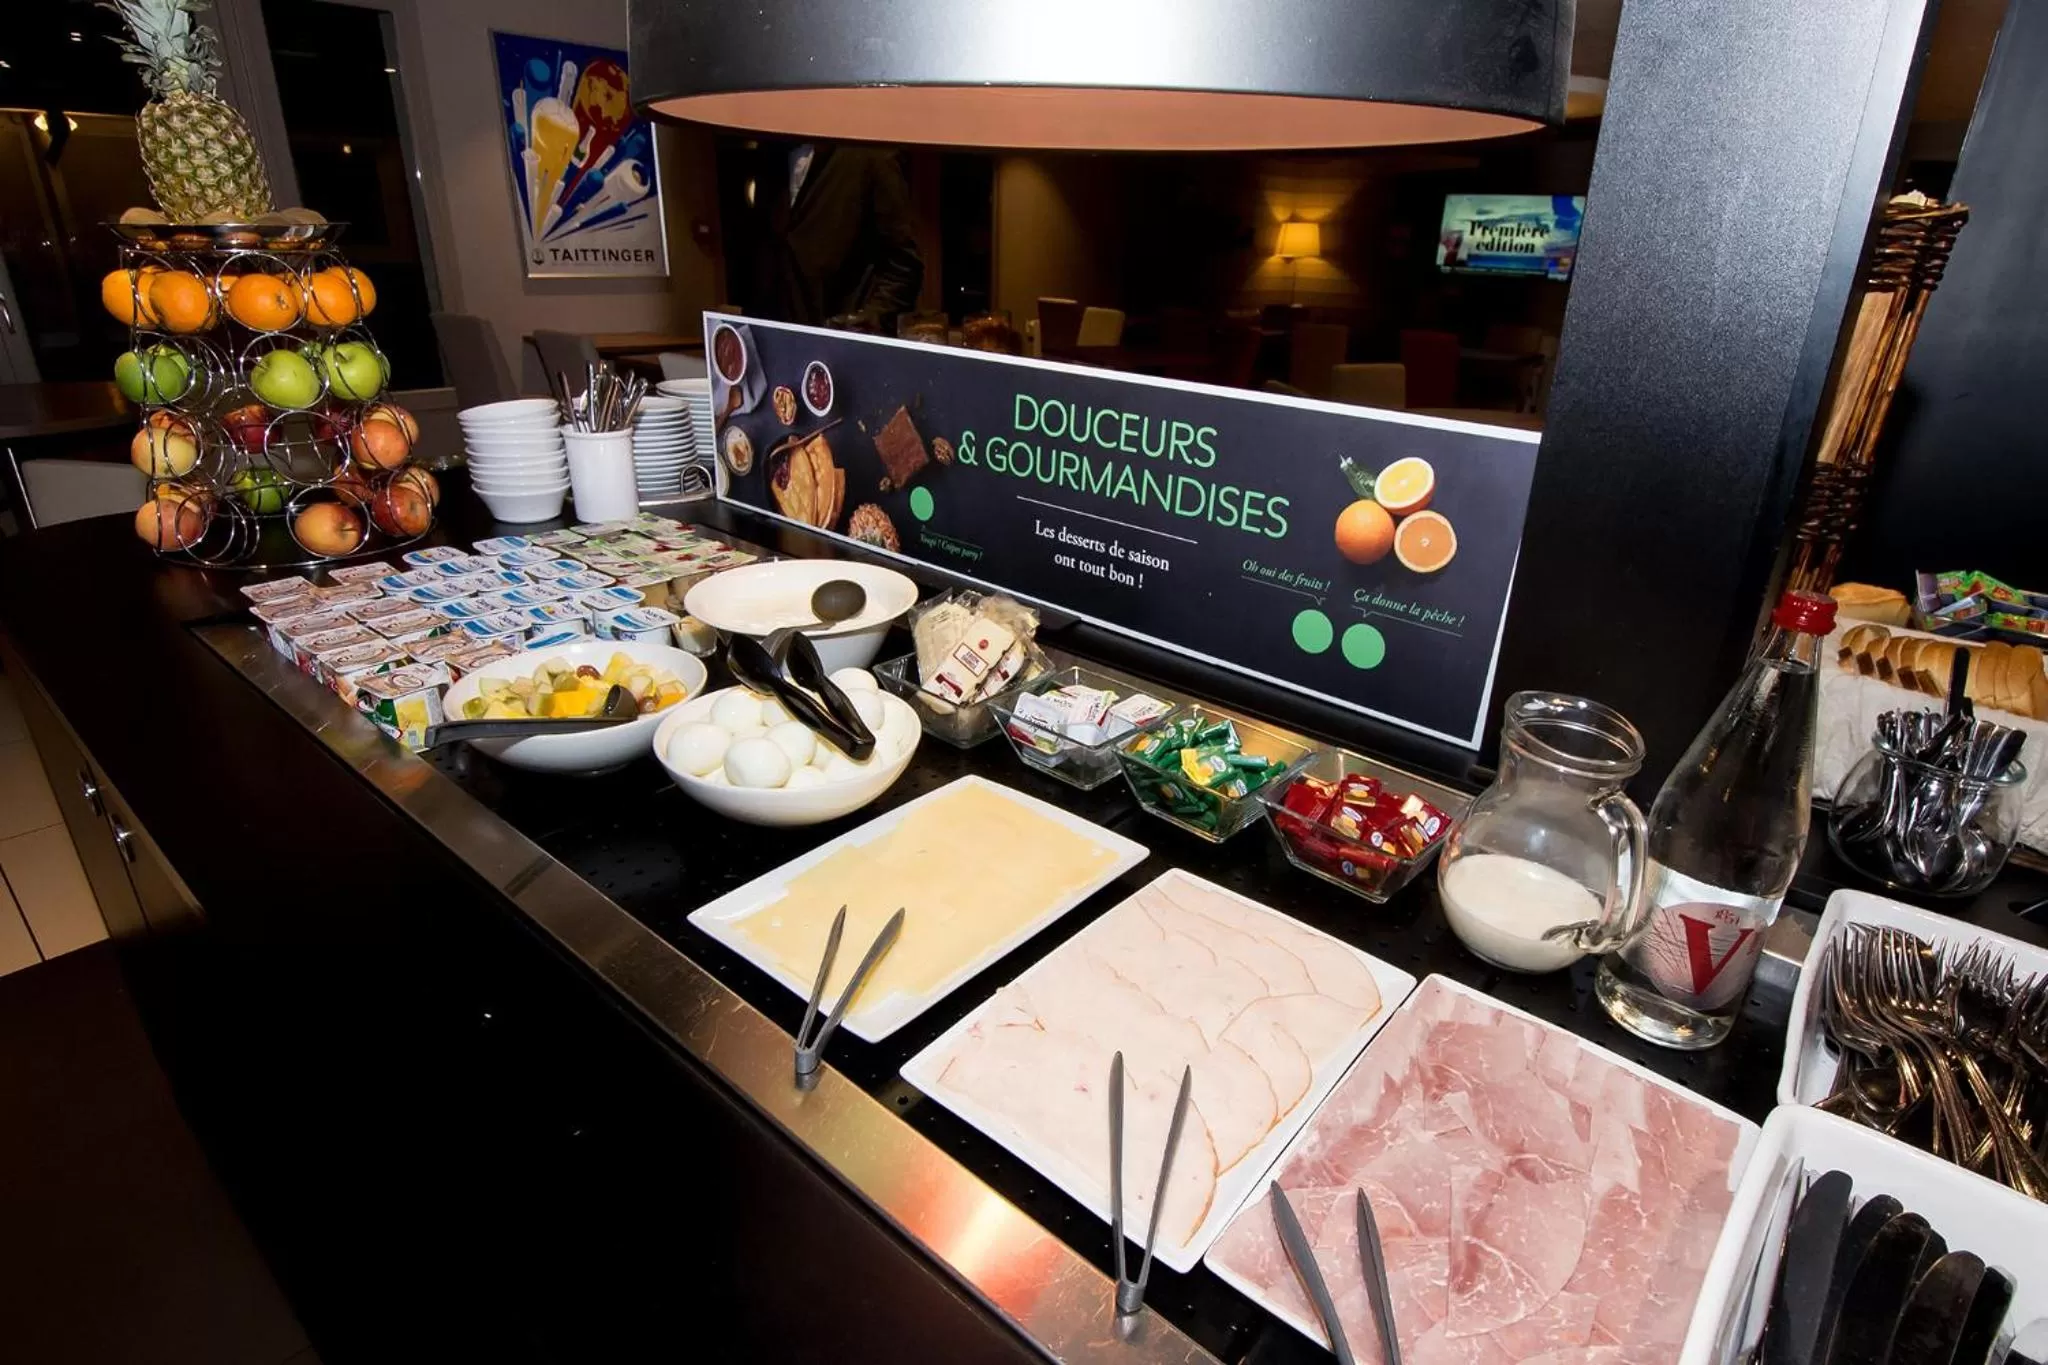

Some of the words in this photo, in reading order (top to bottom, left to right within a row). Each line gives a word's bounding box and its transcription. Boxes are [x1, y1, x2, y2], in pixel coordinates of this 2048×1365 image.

[549, 248, 656, 262] TAITTINGER
[1014, 393, 1219, 468] DOUCEURS
[957, 430, 979, 467] &
[985, 436, 1290, 539] GOURMANDISES
[1035, 519, 1055, 539] Les
[1058, 526, 1106, 553] desserts
[1109, 540, 1125, 558] de
[1128, 549, 1170, 571] saison
[1054, 553, 1076, 569] ont
[1079, 559, 1106, 578] tout
[1242, 559, 1259, 573] Oh
[1260, 567, 1278, 578] oui
[1278, 569, 1294, 583] des
[1353, 588, 1370, 603] Ça
[1371, 593, 1408, 612] donne
[1408, 602, 1421, 616] la
[1678, 913, 1754, 995] V
